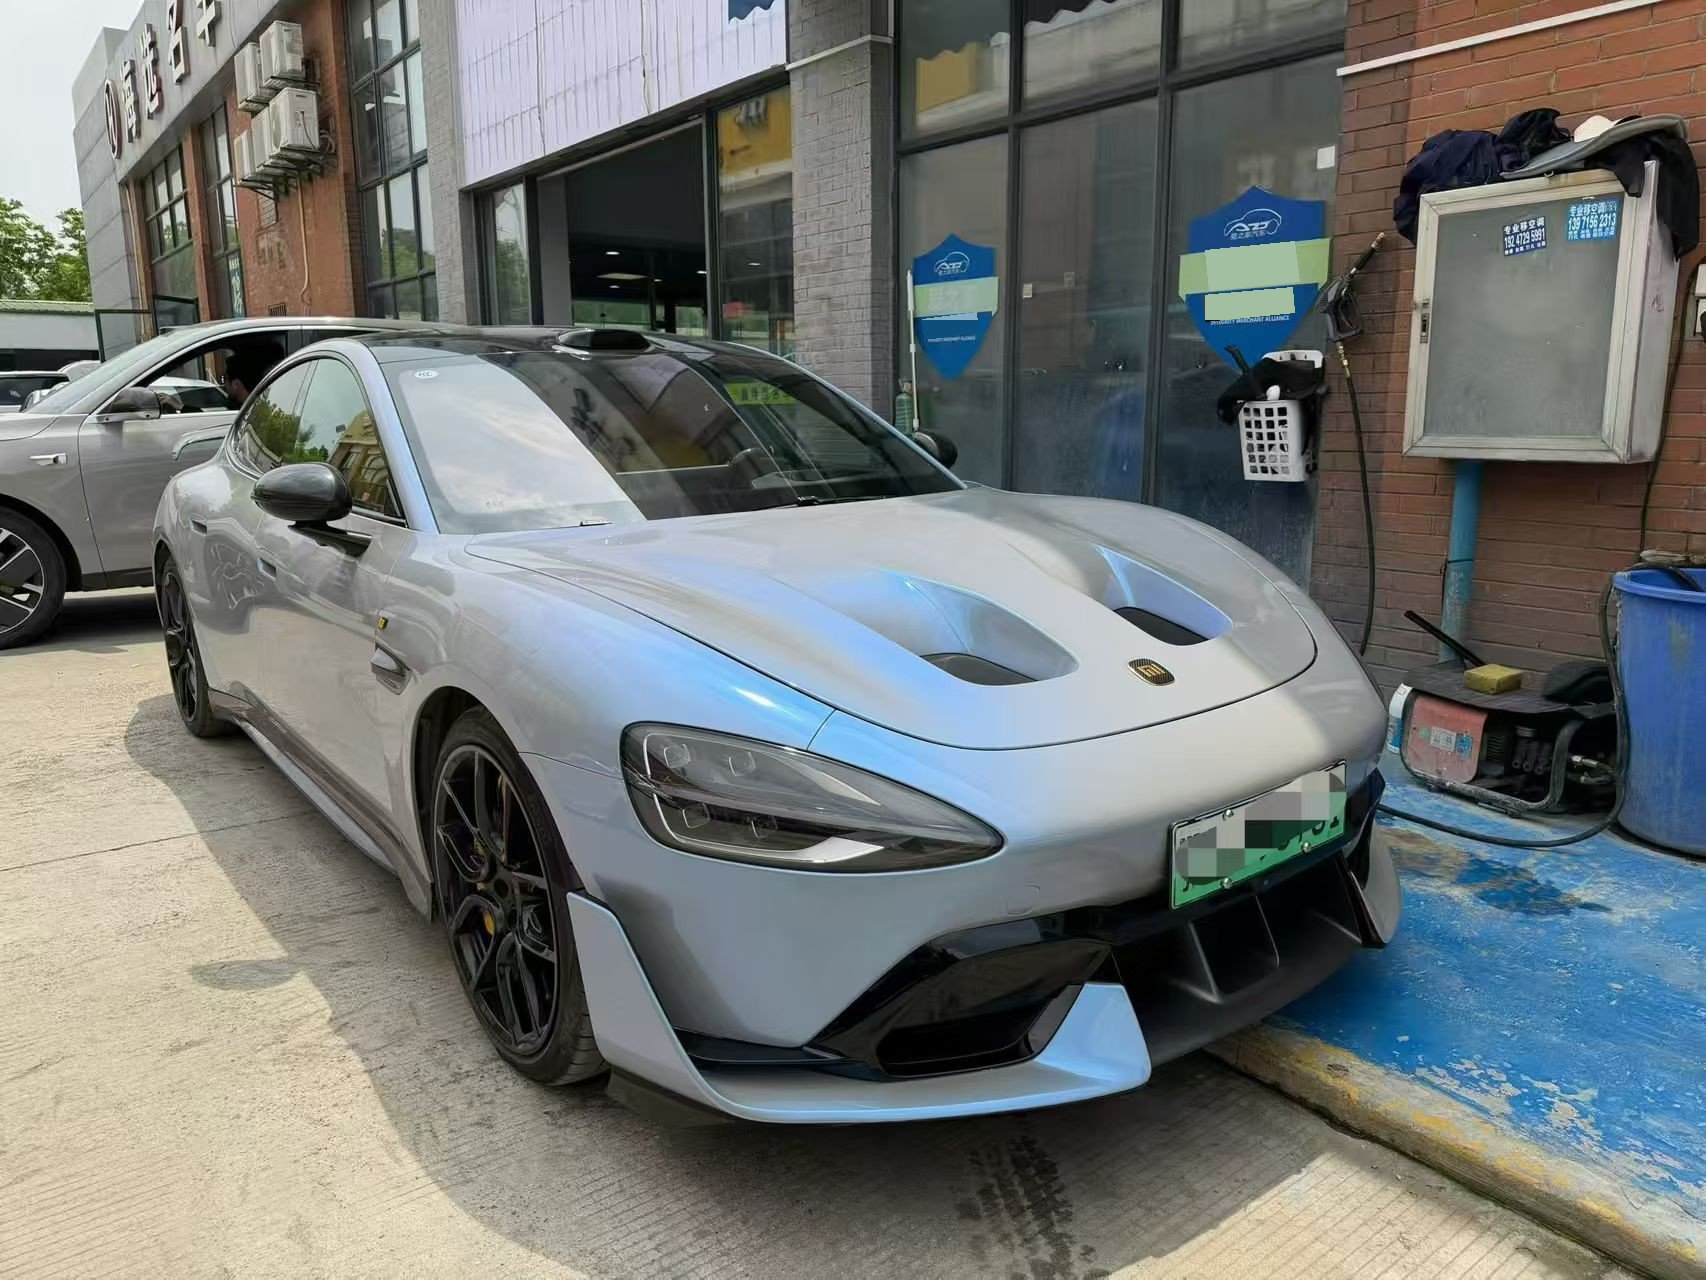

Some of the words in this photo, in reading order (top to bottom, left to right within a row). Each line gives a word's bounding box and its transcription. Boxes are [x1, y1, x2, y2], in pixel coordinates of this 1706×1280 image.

[1504, 216, 1545, 235] 专业移空调
[1568, 216, 1580, 231] 139
[1581, 214, 1599, 230] 7156
[1599, 212, 1616, 228] 2313
[1504, 235, 1516, 249] 192
[1516, 230, 1530, 246] 4729
[1265, 314, 1290, 322] ALLIANCE
